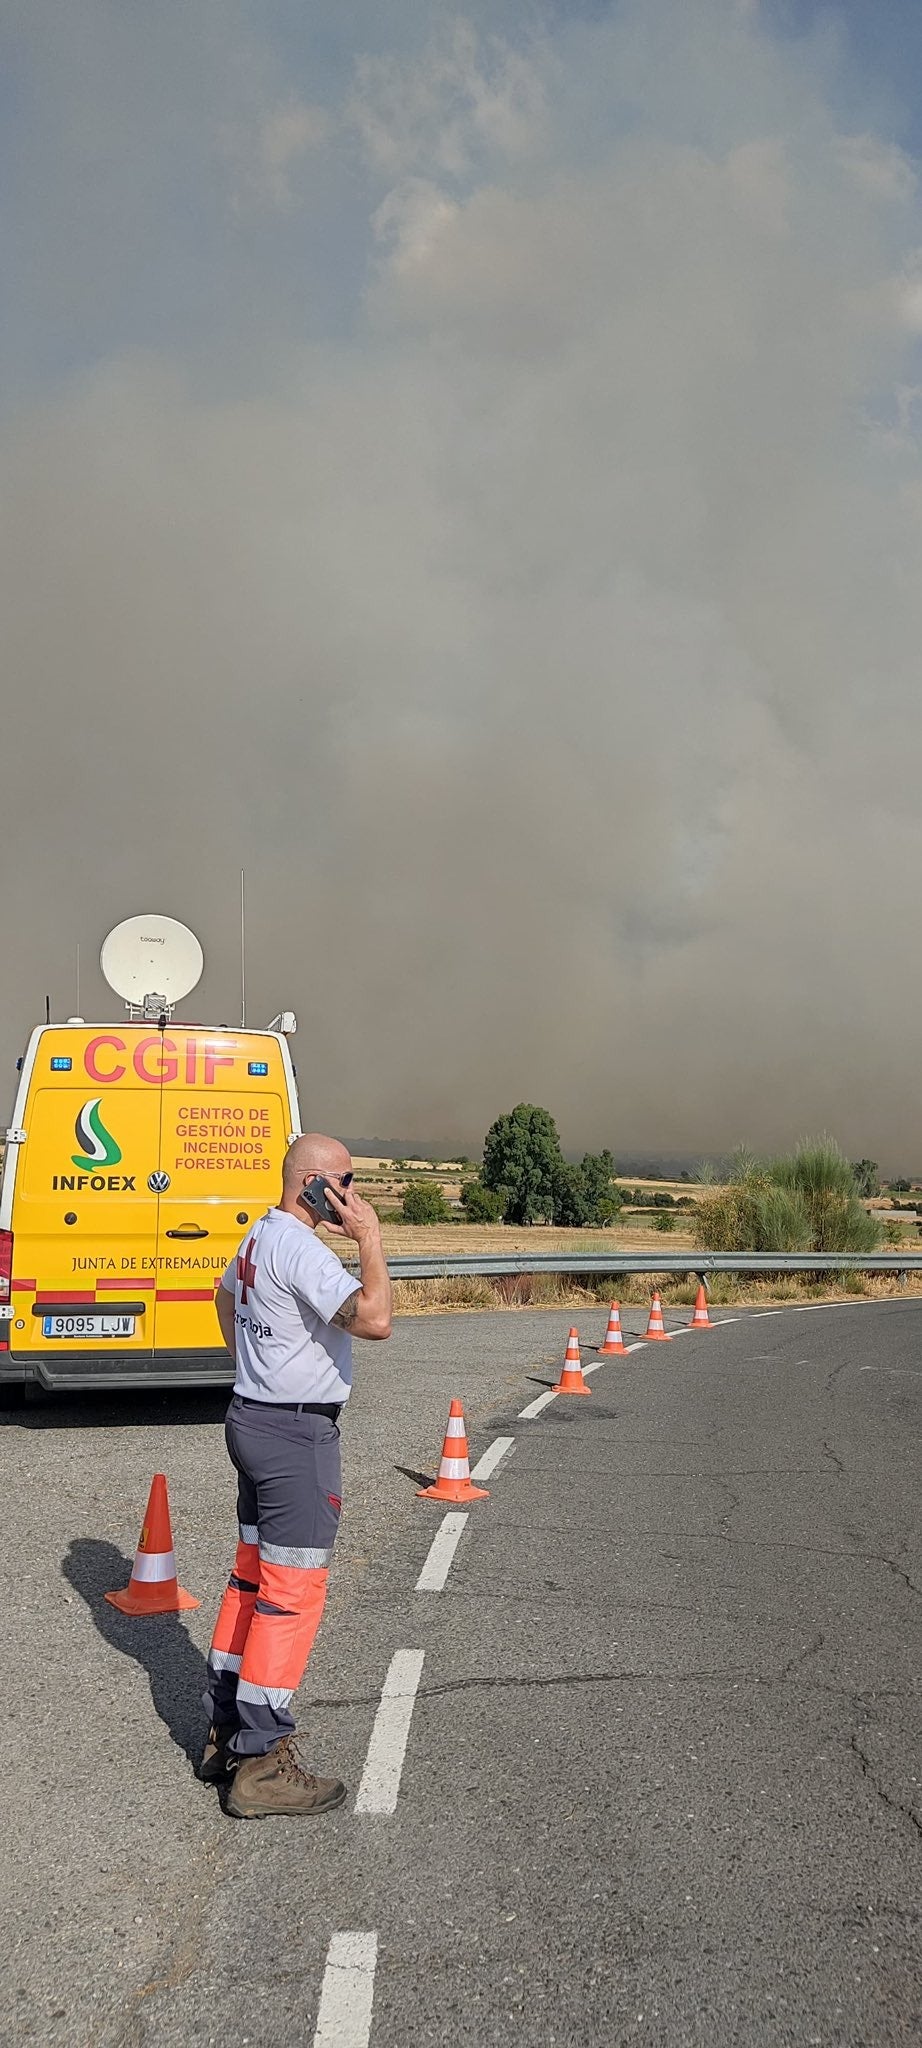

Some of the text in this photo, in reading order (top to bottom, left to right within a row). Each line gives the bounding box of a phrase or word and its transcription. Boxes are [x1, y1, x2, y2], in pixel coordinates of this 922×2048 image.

[83, 1035, 238, 1085] CGIF
[178, 1107, 269, 1121] CENTRO DE
[175, 1121, 271, 1138] GESTIÓN DE
[183, 1142, 263, 1154] INCENDIOS
[175, 1158, 271, 1170] FORESTALES
[52, 1175, 136, 1191] INFOEX
[72, 1256, 228, 1271] JUNTA DE EXTREMADUR
[55, 1318, 131, 1333] 9095 LJW
